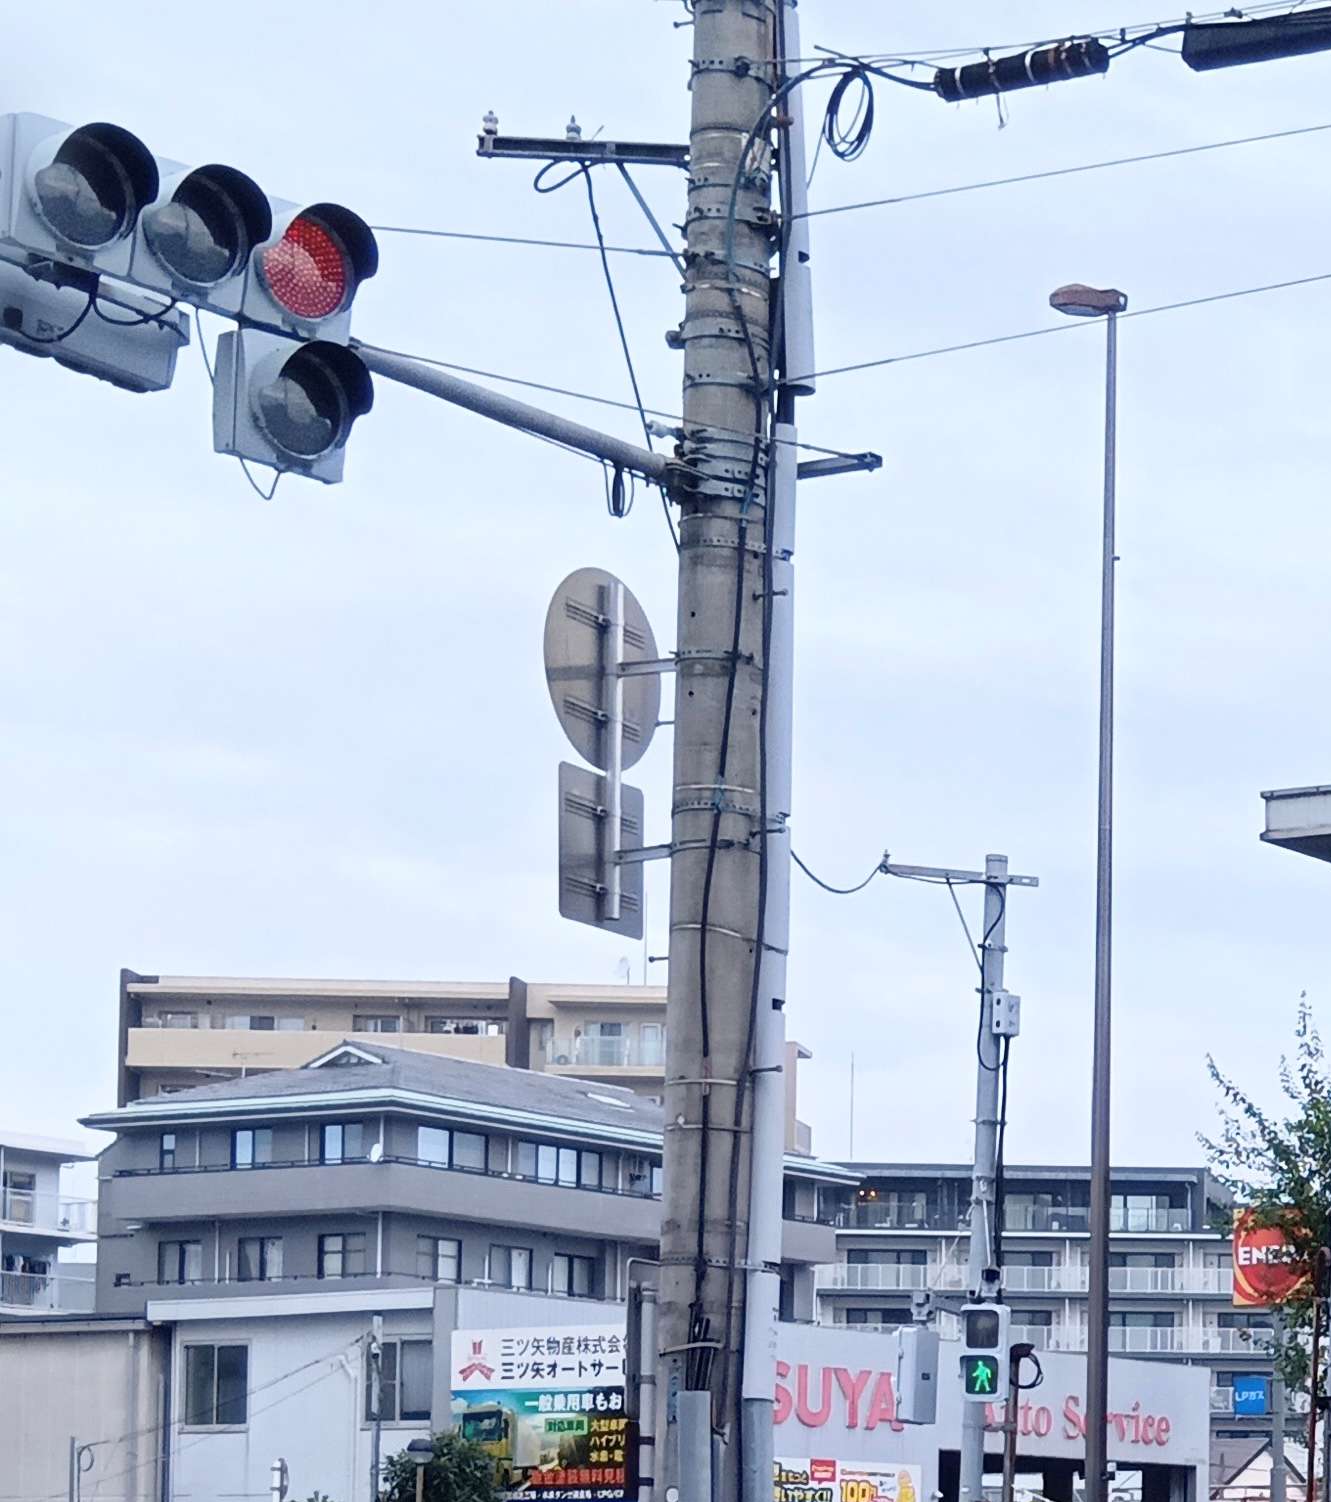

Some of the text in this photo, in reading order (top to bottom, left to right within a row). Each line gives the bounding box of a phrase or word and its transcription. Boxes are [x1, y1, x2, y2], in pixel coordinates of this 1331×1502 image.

[501, 1335, 628, 1356] 三ツ矢物産株式会
